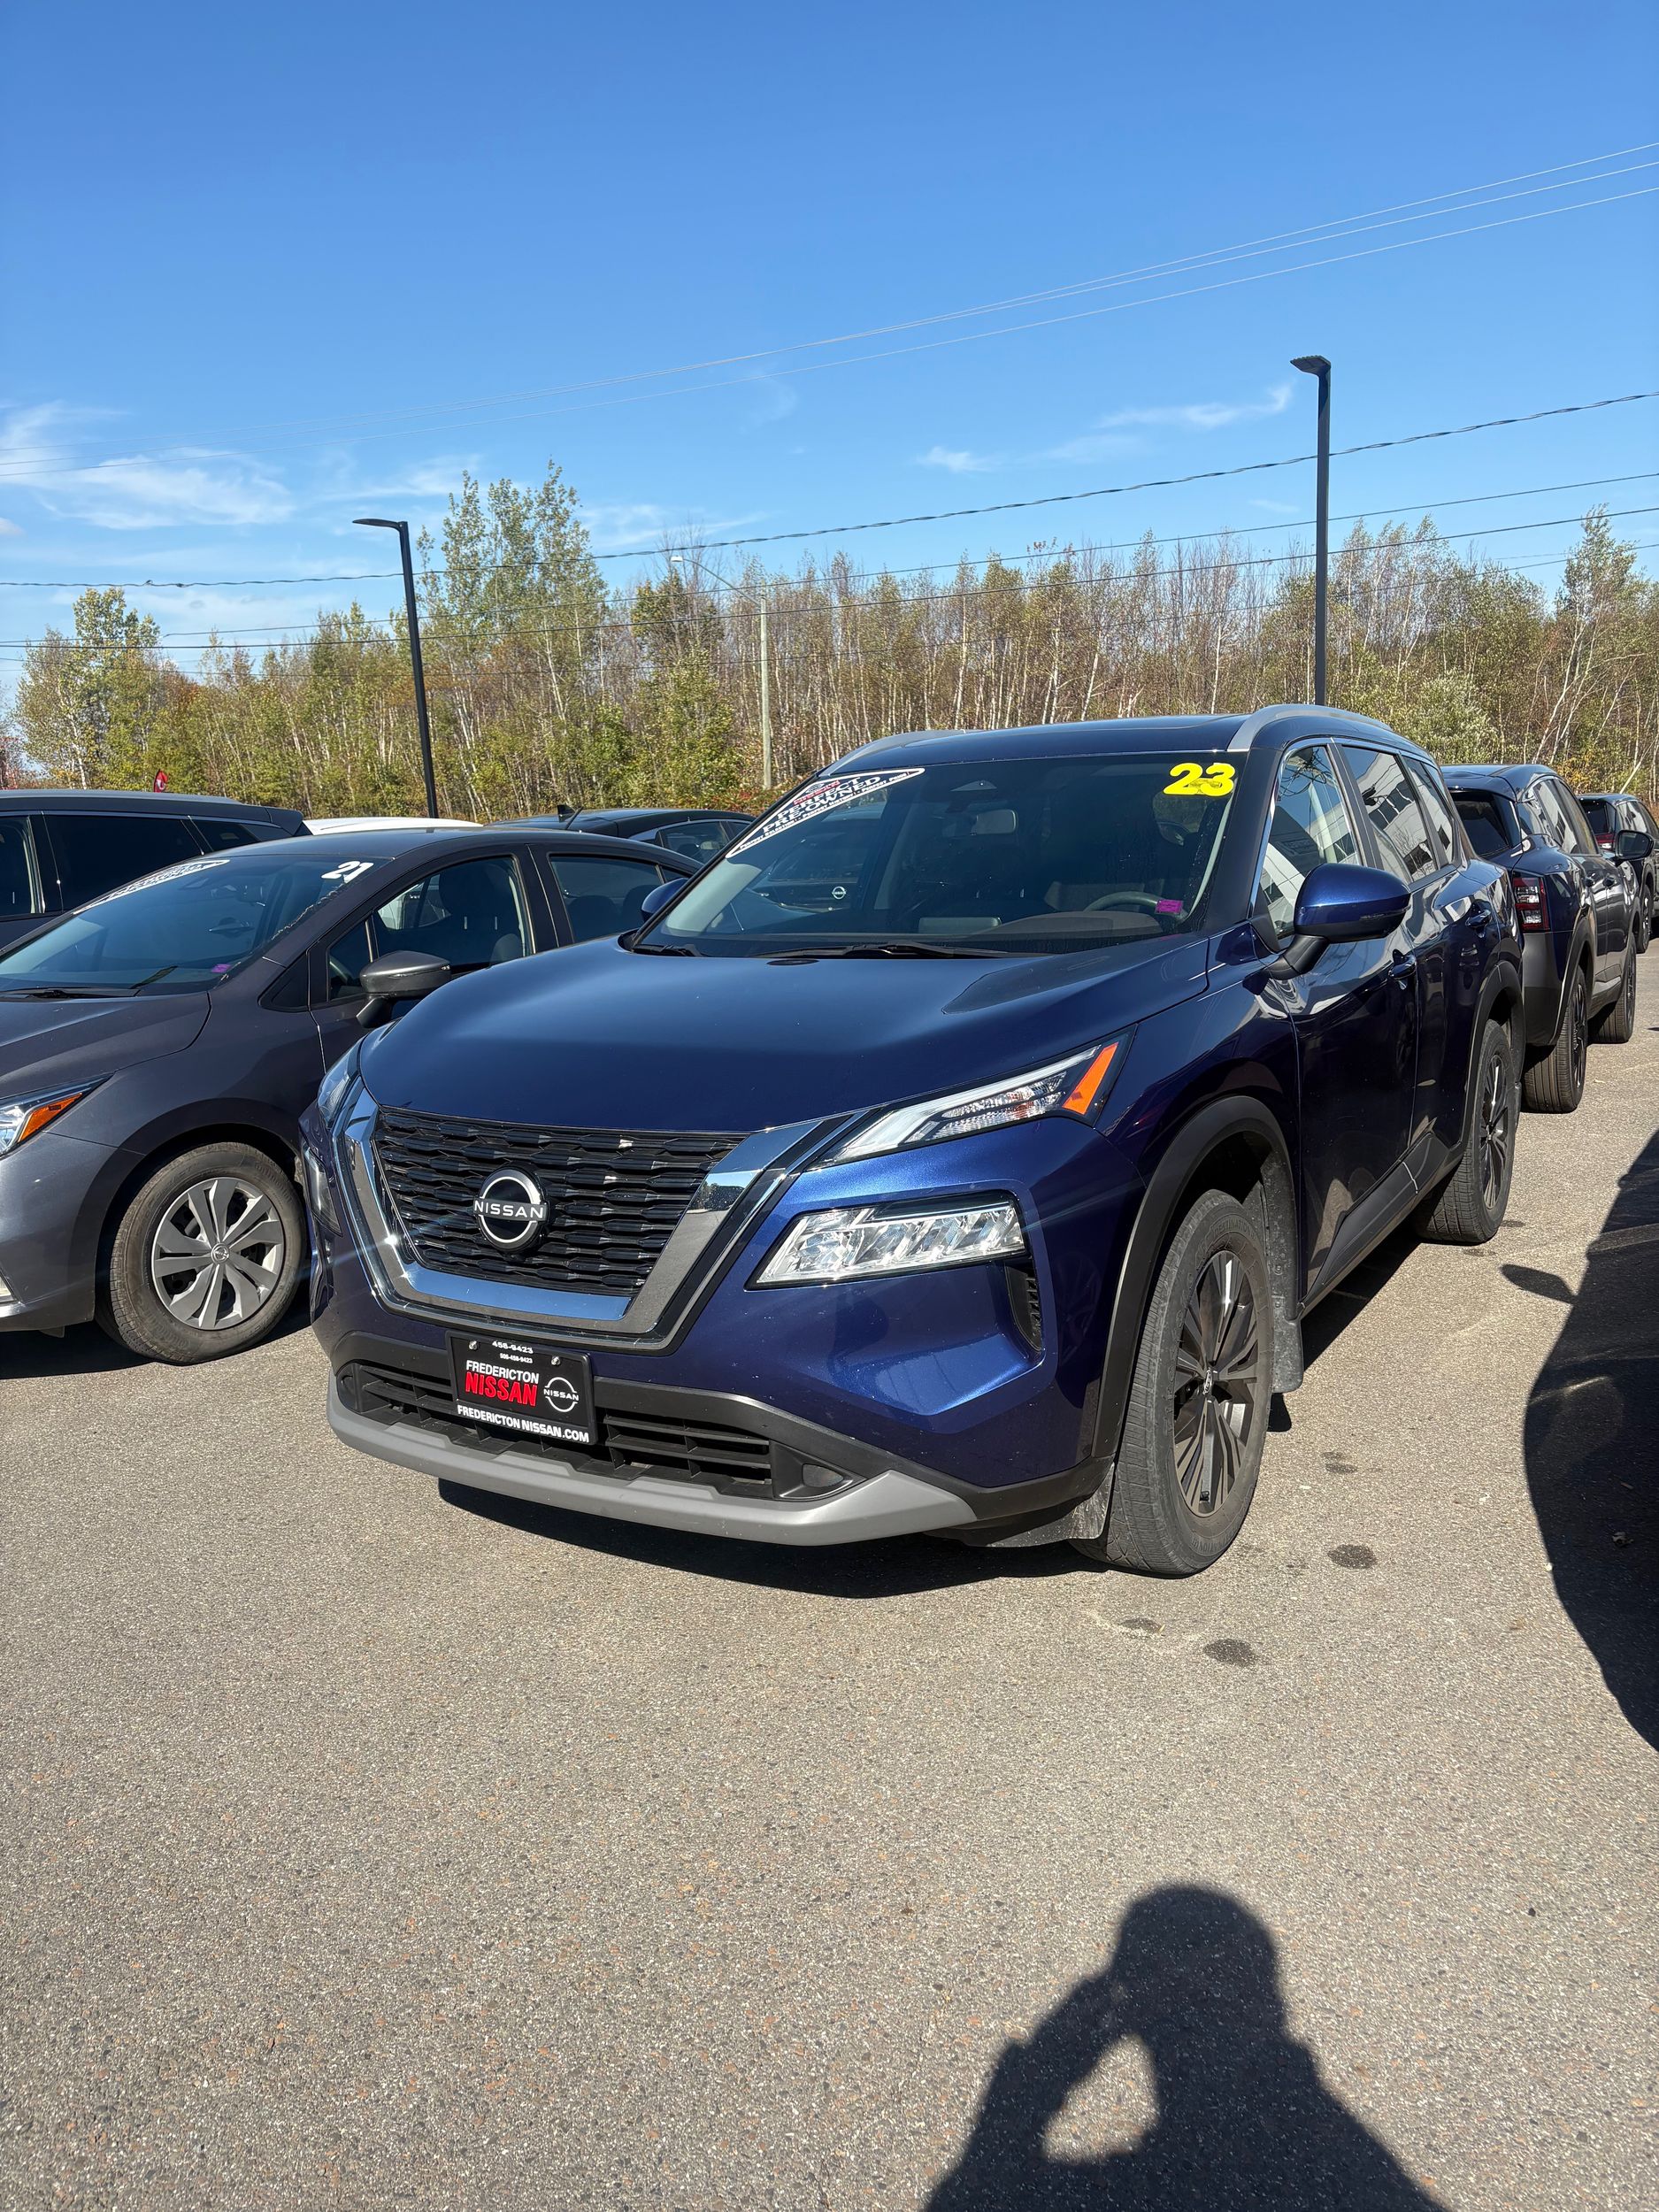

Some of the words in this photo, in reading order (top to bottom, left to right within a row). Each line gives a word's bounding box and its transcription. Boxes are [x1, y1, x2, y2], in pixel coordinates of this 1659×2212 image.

[1163, 762, 1236, 797] 23
[762, 776, 881, 833] PRE-OWNED
[777, 777, 861, 819] PERFECT
[321, 860, 374, 884] 21
[473, 1200, 544, 1219] NISSAN
[465, 1359, 540, 1384] FREDERICTON
[465, 1371, 538, 1407] NISSAN
[543, 1388, 580, 1402] NISSAN
